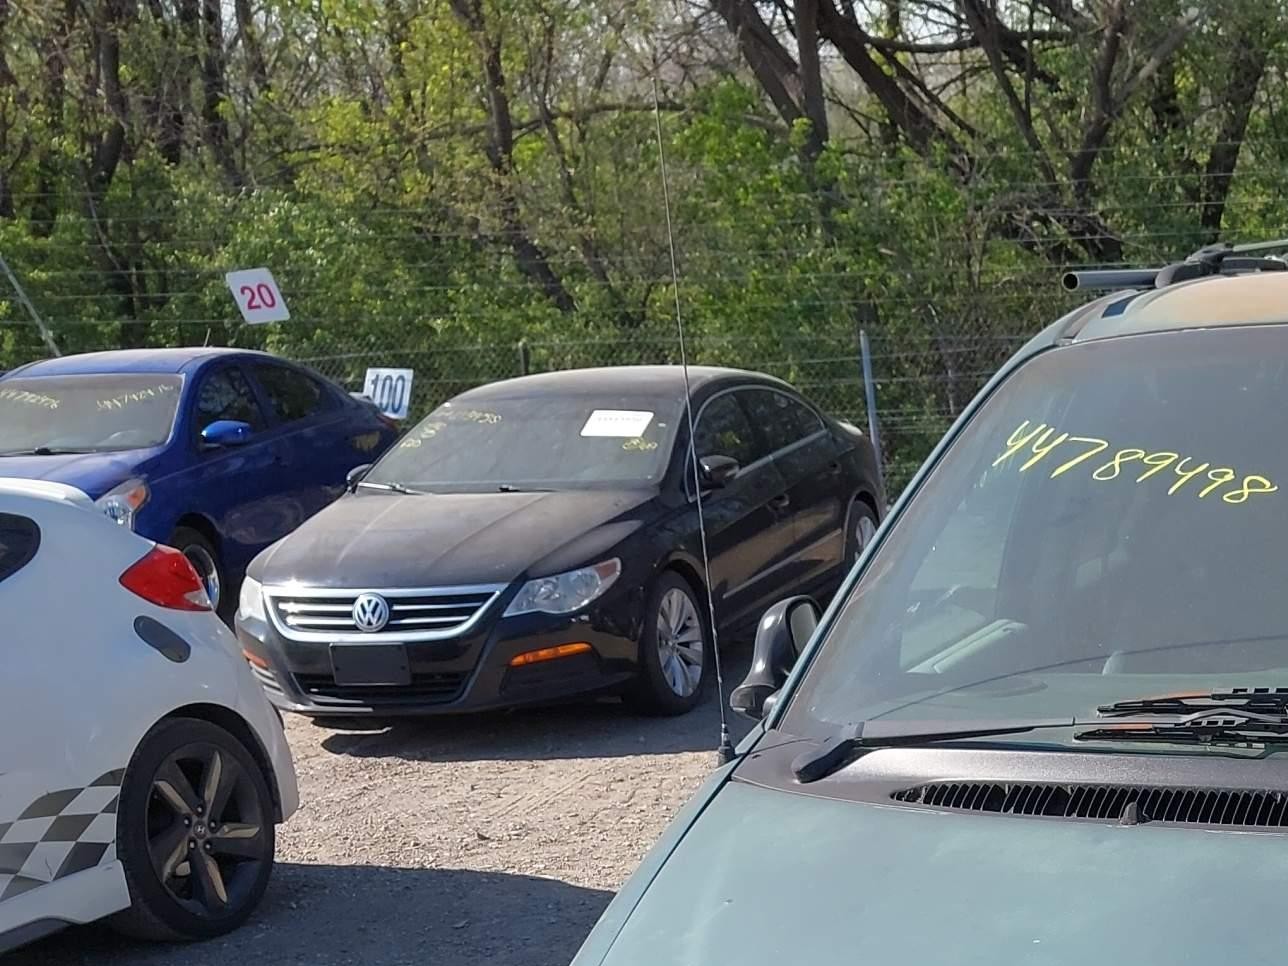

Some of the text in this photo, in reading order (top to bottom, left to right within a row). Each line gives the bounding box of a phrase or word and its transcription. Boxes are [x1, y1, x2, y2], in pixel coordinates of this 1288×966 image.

[240, 283, 276, 310] 20
[371, 373, 406, 414] 100
[992, 420, 1279, 504] 44789498
